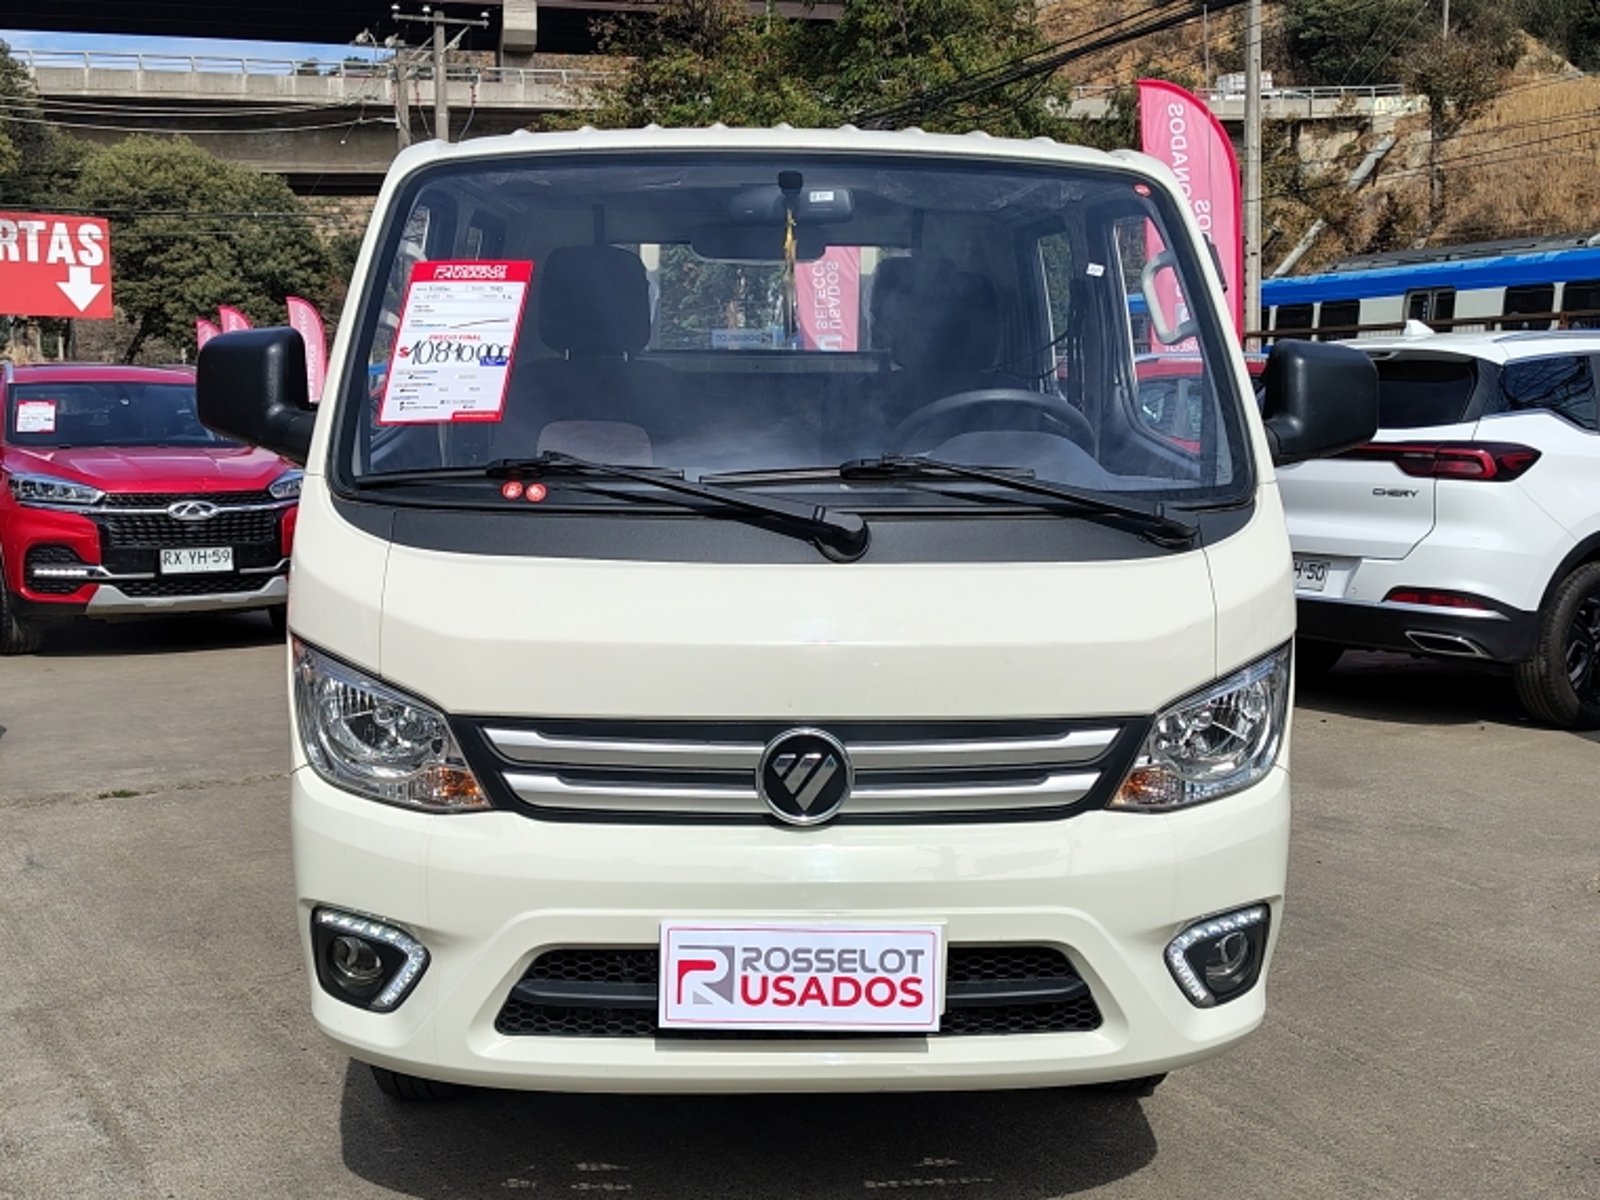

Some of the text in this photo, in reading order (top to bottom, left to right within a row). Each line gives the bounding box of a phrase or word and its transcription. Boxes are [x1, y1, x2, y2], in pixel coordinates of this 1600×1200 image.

[1372, 488, 1419, 498] CHERY
[741, 947, 925, 974] ROSSELOT
[740, 975, 924, 1008] USADOS
